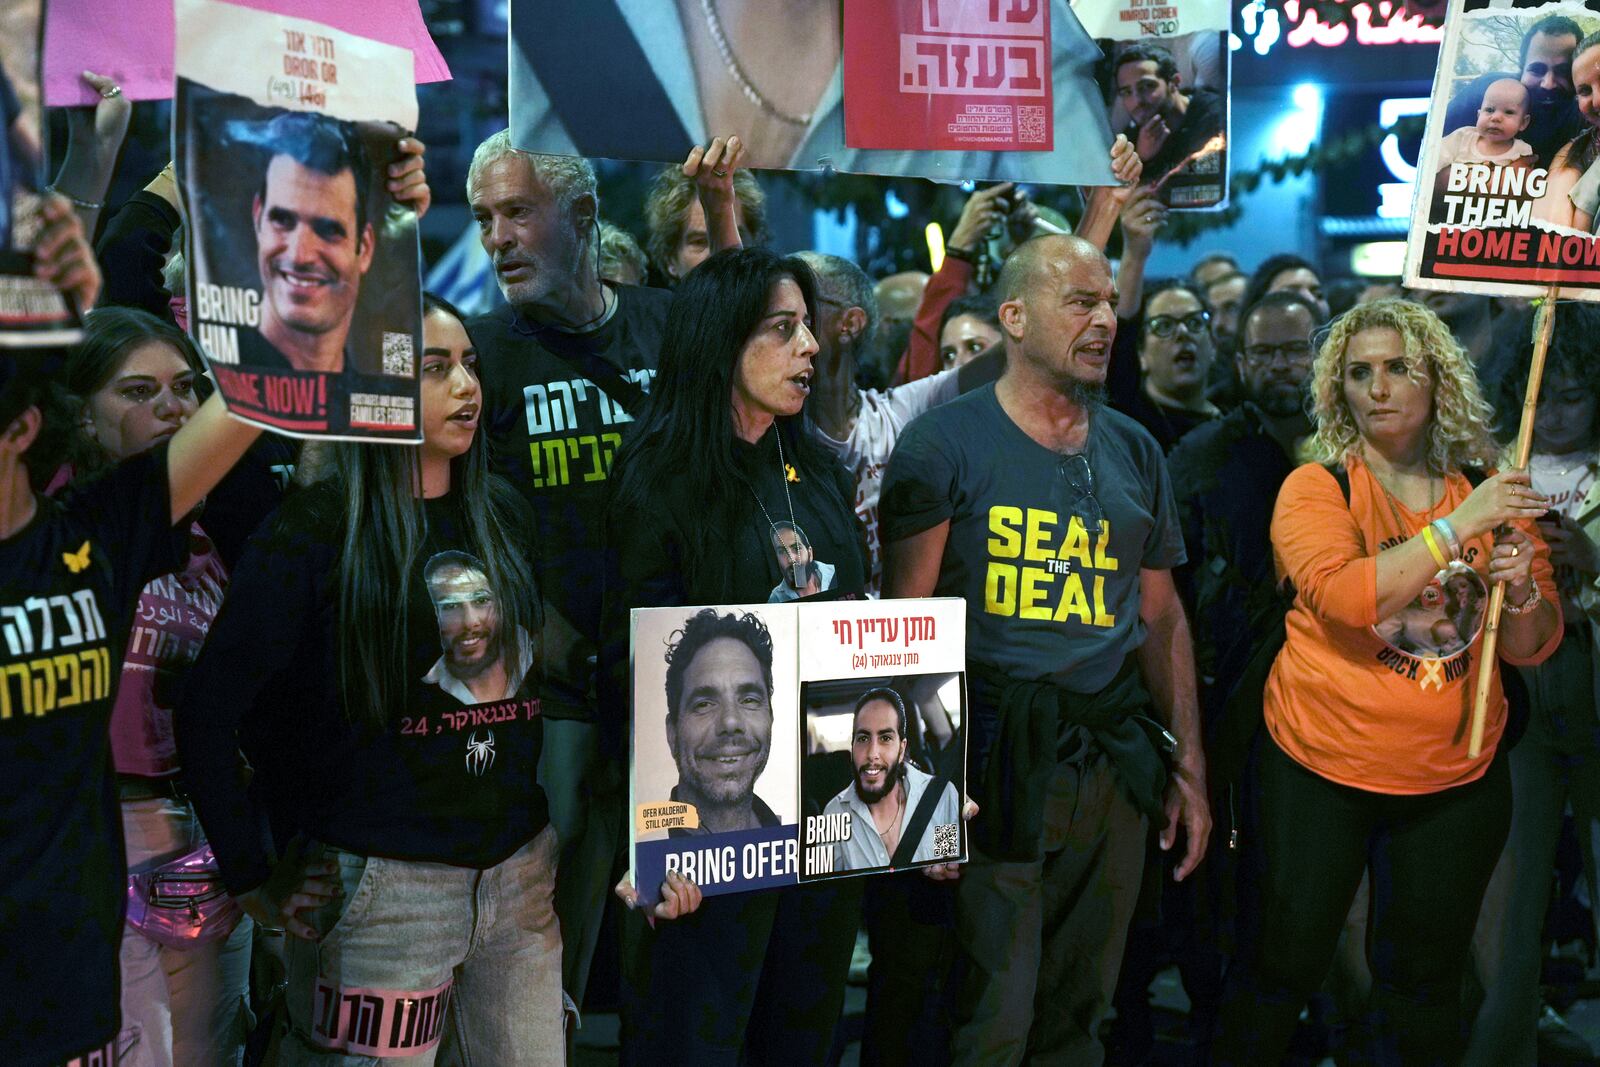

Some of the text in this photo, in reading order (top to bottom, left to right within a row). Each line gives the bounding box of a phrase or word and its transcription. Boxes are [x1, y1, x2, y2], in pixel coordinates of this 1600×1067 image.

[1120, 7, 1178, 21] NIMROD COHEN
[903, 43, 1042, 90] בעזה.
[1447, 163, 1549, 198] BRING
[1444, 195, 1533, 229] THEM
[1437, 228, 1531, 261] HOME
[197, 283, 261, 327] BRING
[201, 323, 240, 365] HIM
[264, 374, 327, 416] NOW!
[988, 505, 1118, 571] SEAL
[1047, 560, 1071, 574] THE
[984, 562, 1115, 627] DEAL
[832, 616, 936, 650] מתן עדיין חי
[852, 652, 919, 670] מתן צנגאוקר (24)
[1376, 646, 1420, 681] BACK
[400, 716, 429, 736] 24
[643, 805, 688, 818] OFER KALDERON
[645, 816, 685, 830] STILL CAPTIVE
[806, 812, 851, 845] BRING
[742, 839, 798, 879] OFER
[805, 845, 834, 876] HIM
